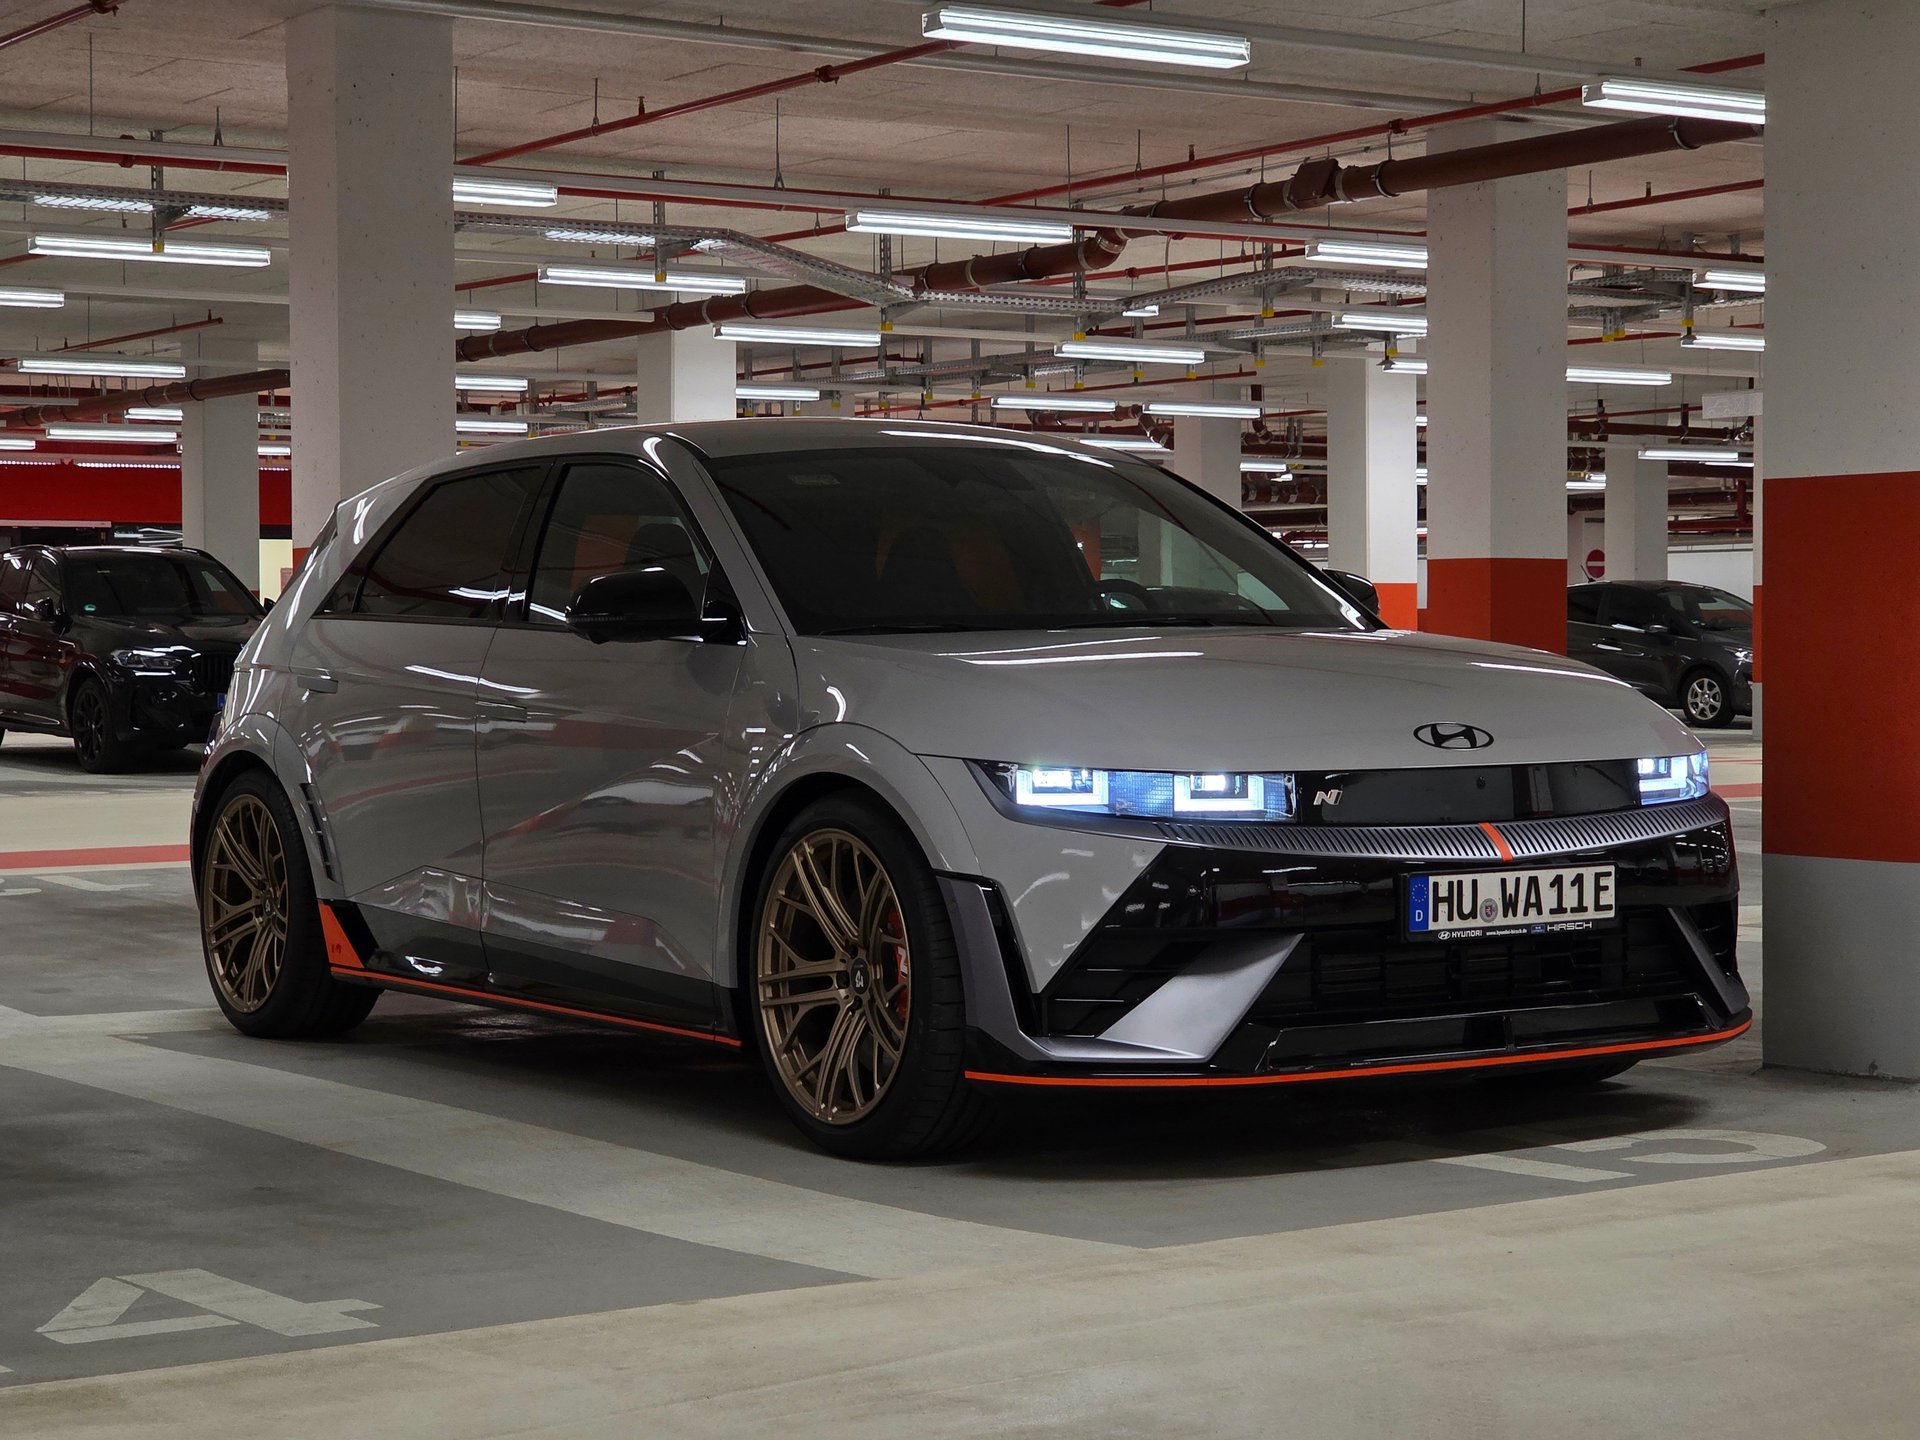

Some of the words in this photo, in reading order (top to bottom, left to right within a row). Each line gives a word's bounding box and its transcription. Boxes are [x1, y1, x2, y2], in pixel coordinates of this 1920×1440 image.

[1432, 879, 1478, 923] HU
[1415, 909, 1424, 923] D
[1547, 921, 1593, 932] HIRSCH
[1452, 930, 1483, 939] HYUNDAI
